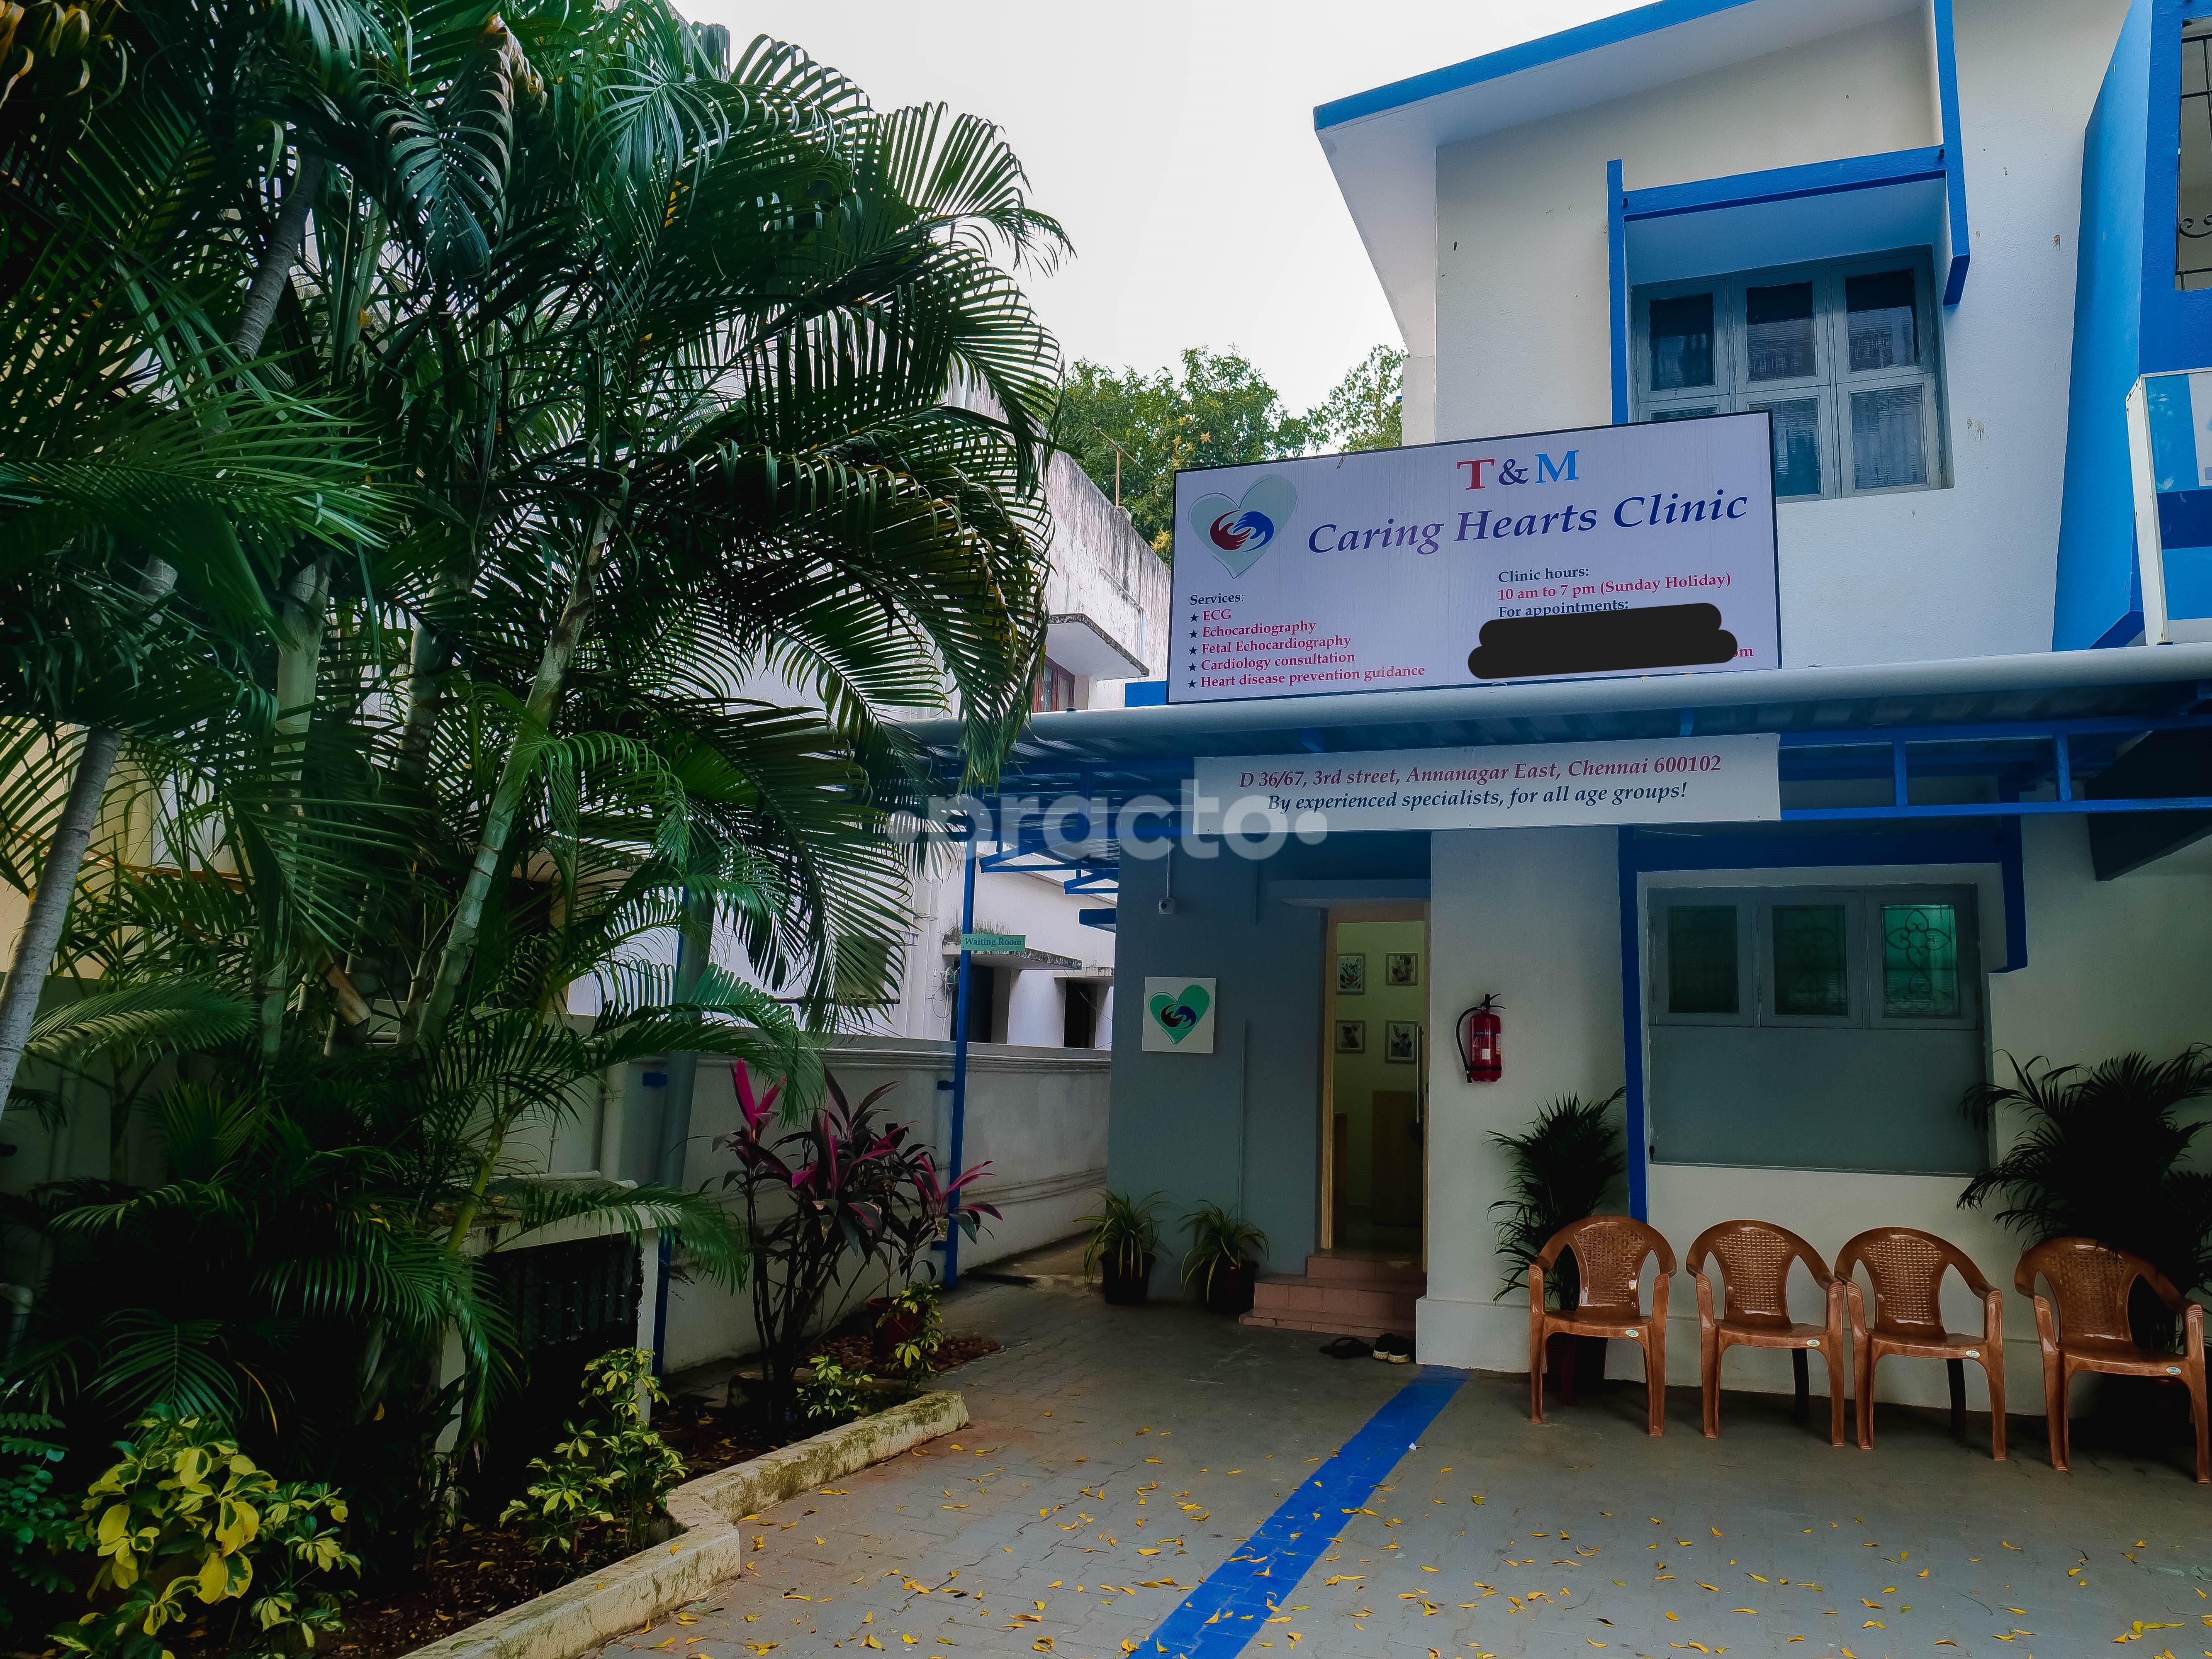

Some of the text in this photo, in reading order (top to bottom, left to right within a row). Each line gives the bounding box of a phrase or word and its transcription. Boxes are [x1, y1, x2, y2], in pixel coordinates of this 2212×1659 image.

[1308, 489, 1748, 555] Caring Hearts Clinic
[1498, 567, 1589, 582] Clinic hours:
[1498, 572, 1731, 600] 10 am to 7 pm (Sunday Holiday)
[1190, 593, 1244, 605] Services:
[1203, 609, 1231, 621] ECG
[1498, 600, 1628, 618] For appointments:
[1203, 620, 1316, 637] Echocardiography
[1202, 635, 1351, 654] Fetal Echocardiography
[1201, 652, 1355, 671] Cardiology consultation
[1201, 665, 1425, 687] Heart disease prevention guidance
[1239, 755, 1722, 788] D 36/67, 3rd street, Annanagar East, Chennai 600102
[1267, 782, 1688, 814] By experienced specialists, for all age groups!
[965, 938, 996, 947] Waiting
